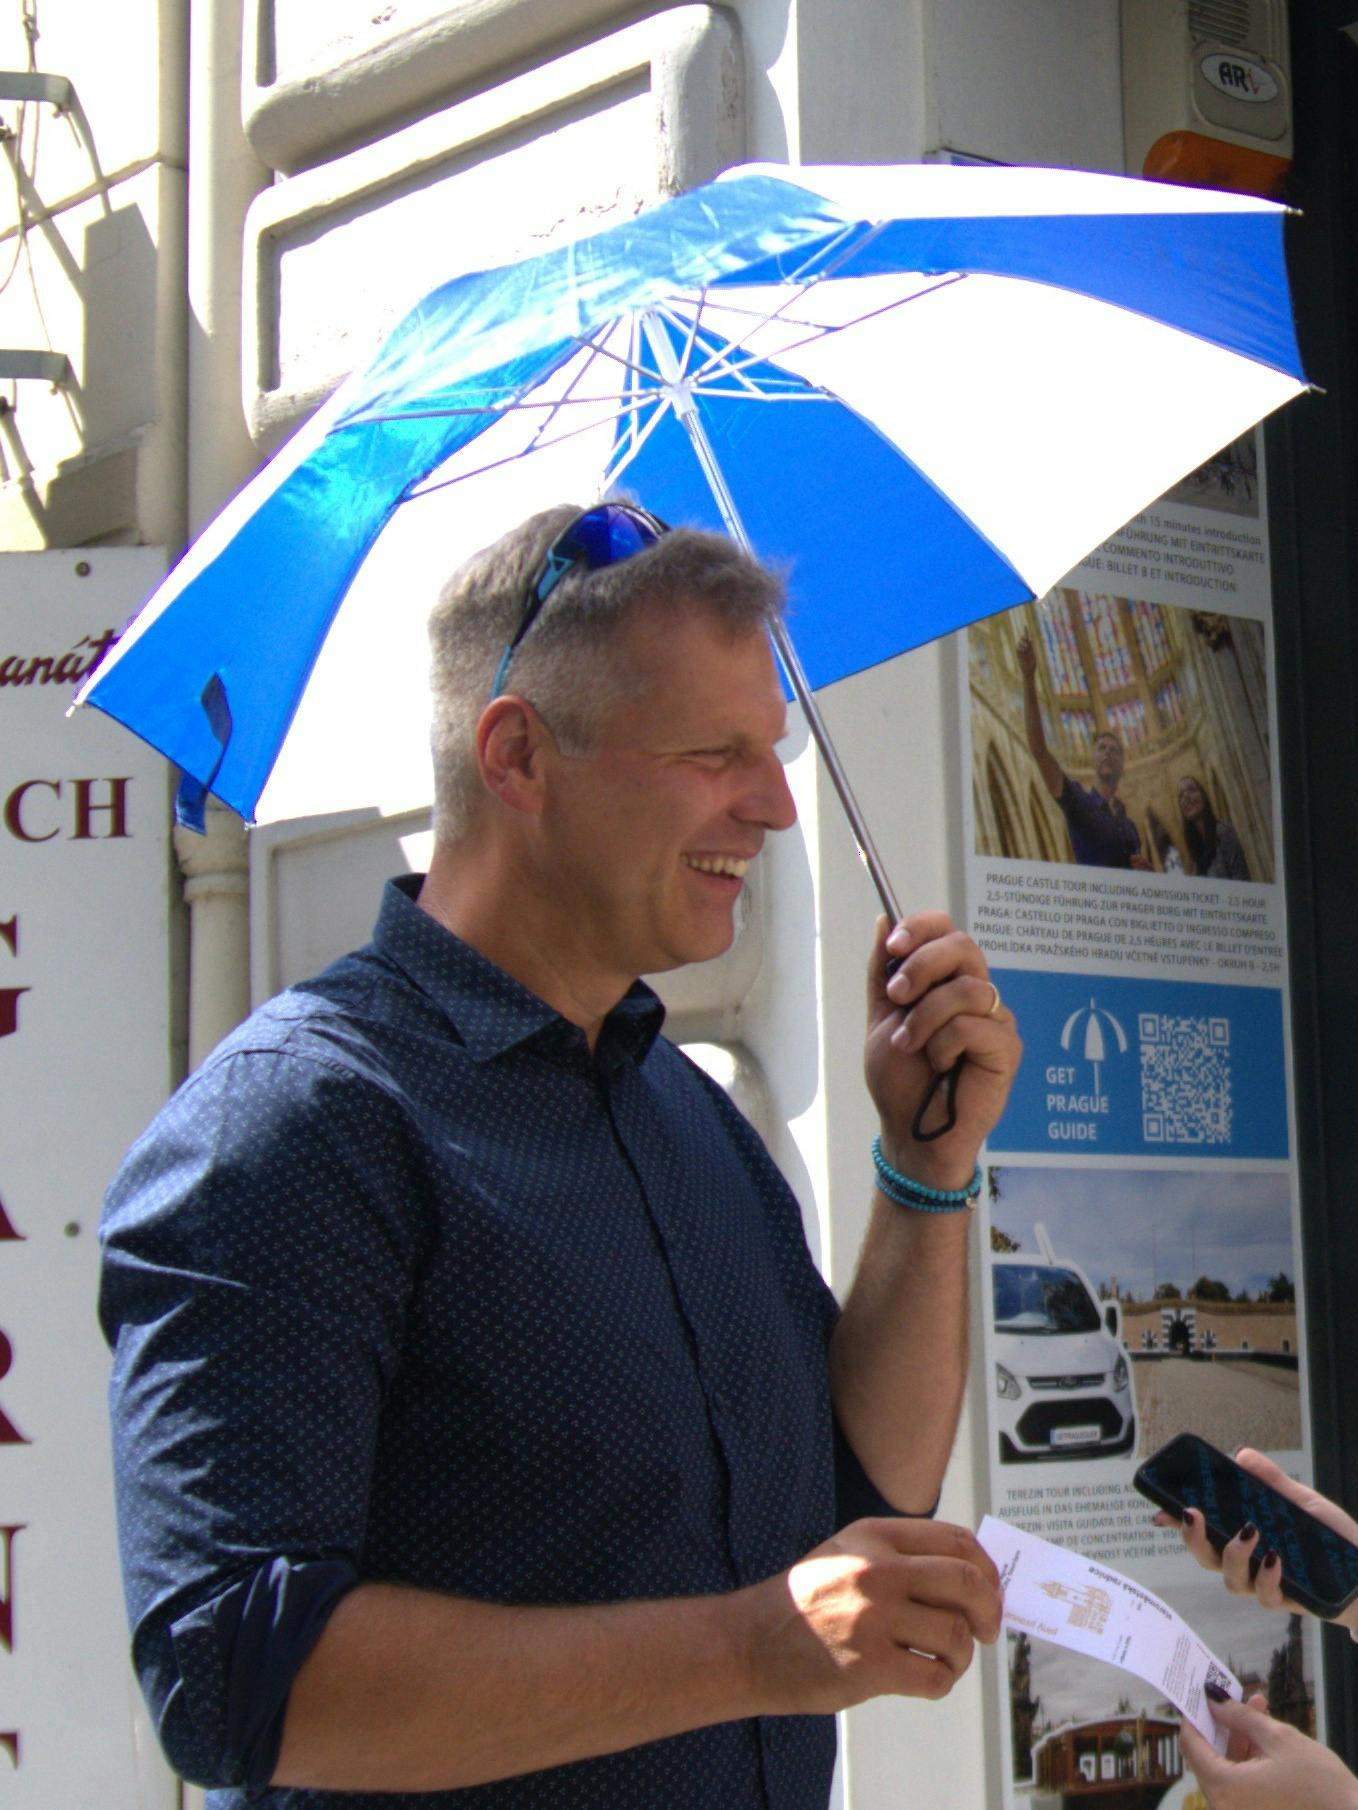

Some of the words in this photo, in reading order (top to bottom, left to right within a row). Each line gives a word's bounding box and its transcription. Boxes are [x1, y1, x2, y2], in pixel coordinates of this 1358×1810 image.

[1163, 519, 1200, 534] minutes
[1204, 526, 1261, 545] introduction
[1103, 542, 1161, 562] COMMENTO
[1163, 552, 1233, 576] INTRODUTTIVO
[1107, 560, 1138, 575] BILLET
[1150, 567, 1162, 579] ET
[1164, 571, 1236, 592] INTRODUCTION
[986, 873, 1024, 887] PRAGUE
[1026, 877, 1060, 890] CASTLE
[1063, 880, 1086, 892] TOUR
[1090, 883, 1138, 897] INCLUDING
[1141, 887, 1189, 901] ADMISSION
[1192, 893, 1219, 905] TICKET
[1242, 896, 1265, 908] HOUR
[1101, 900, 1118, 912] ZUR
[1120, 902, 1154, 914] PRAGER
[1157, 905, 1180, 917] BURG
[1183, 907, 1198, 918] MIT
[1015, 909, 1060, 923] CASTELLO
[1063, 913, 1072, 924] DI
[1076, 914, 1105, 926] PRAGA
[1108, 916, 1128, 928] CON
[1130, 919, 1175, 933] BIGLIETTO
[1061, 929, 1073, 940] DE
[1076, 930, 1111, 943] PRAGUE
[1114, 934, 1126, 944] DE
[1180, 939, 1200, 951] AVEC
[1092, 948, 1123, 961] HRADU
[1046, 1066, 1075, 1085] GET
[1046, 1094, 1110, 1114] PRAGUE
[1047, 1121, 1097, 1141] GUIDE
[1046, 1486, 1070, 1498] TOUR
[1072, 1484, 1121, 1497] INCLUDING
[999, 1504, 1040, 1518] AUSFLUG
[1042, 1503, 1052, 1514] IN
[1054, 1502, 1073, 1514] DAS
[1075, 1500, 1124, 1513] EHEMALIGE
[1046, 1519, 1074, 1530] VISITA
[1076, 1516, 1114, 1529] GUIDATA
[1116, 1514, 1131, 1525] DEL
[1066, 1536, 1078, 1546] DE
[1080, 1531, 1154, 1545] CONCENTRATION
